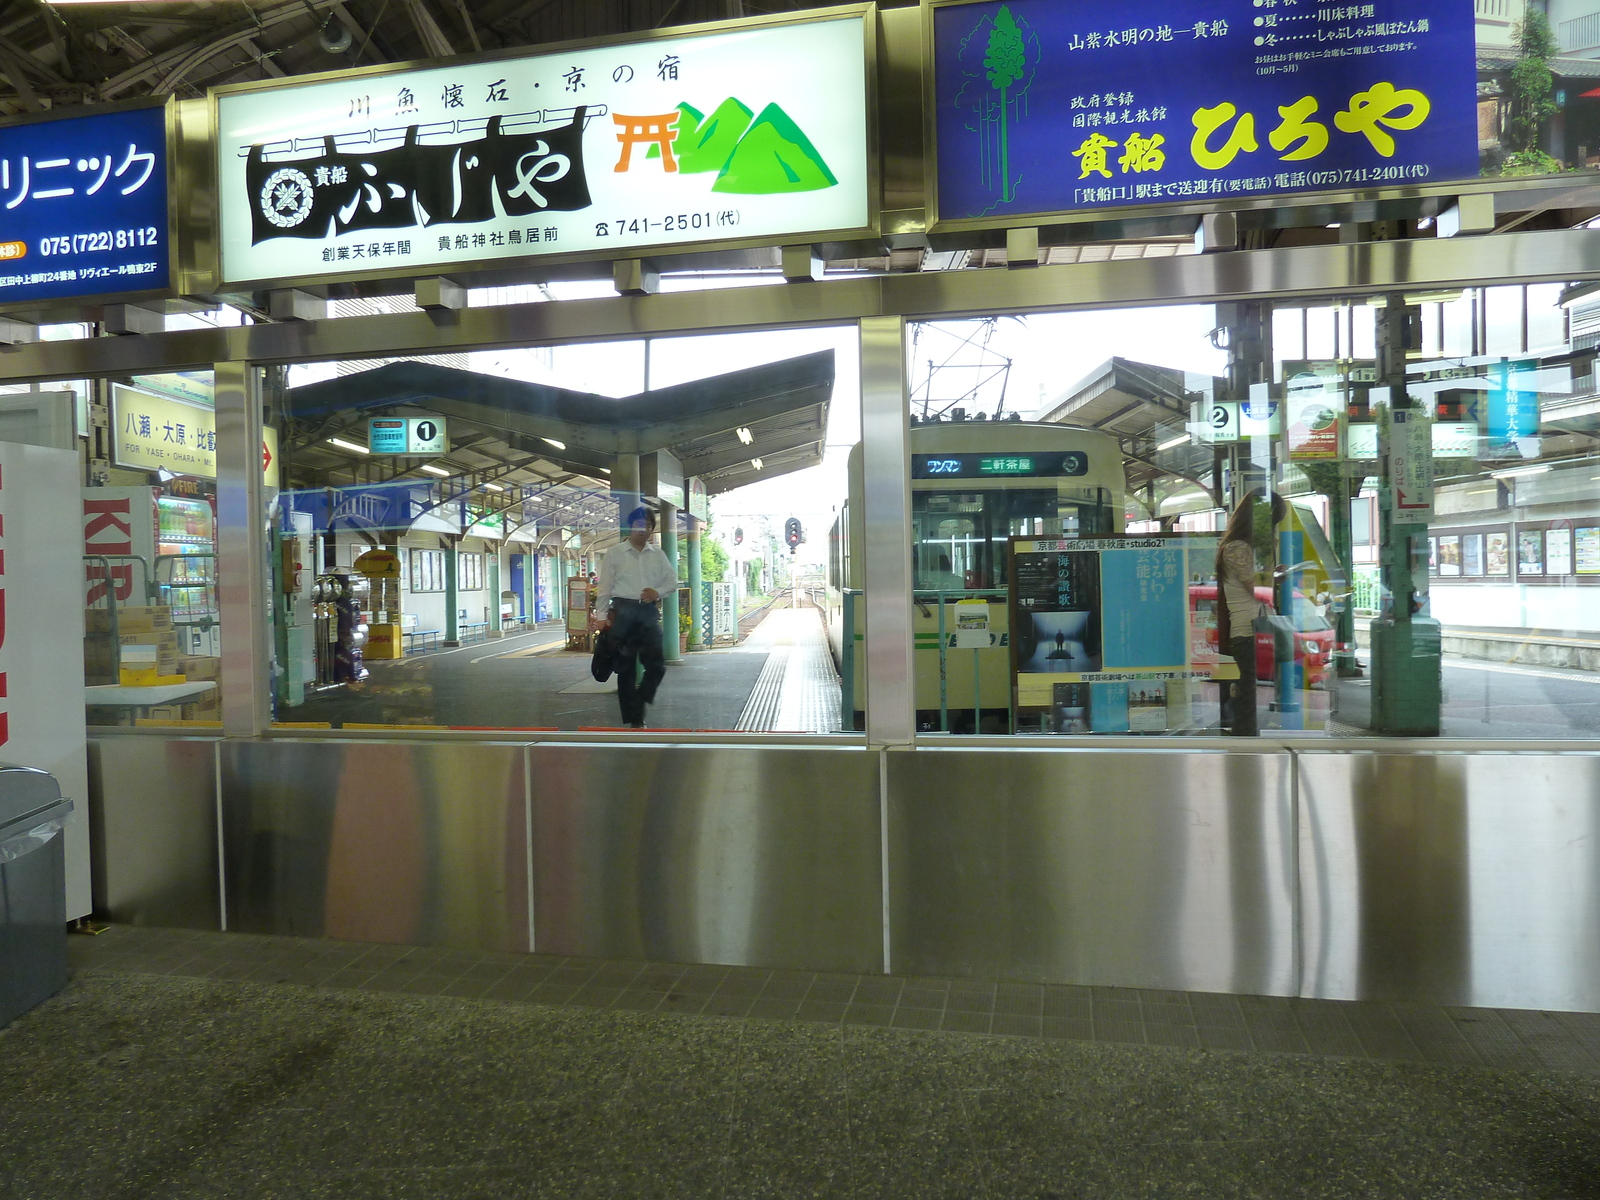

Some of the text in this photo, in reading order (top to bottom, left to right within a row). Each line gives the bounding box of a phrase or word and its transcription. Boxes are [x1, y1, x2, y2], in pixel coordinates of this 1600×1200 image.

[1070, 91, 1135, 110] 政府登録
[1190, 81, 1431, 171] ひろや
[1071, 132, 1167, 181] 貴船
[313, 165, 350, 188] 貴船
[39, 226, 158, 257] 075(722)8112
[320, 225, 559, 262] 創業天保年間 貴船神社鳥居前
[1211, 407, 1226, 426] 2
[420, 422, 430, 439] 1
[125, 443, 140, 454] FOR
[145, 447, 164, 458] YASE
[173, 452, 195, 463] OHARA
[927, 458, 1031, 473] ワンマン 二軒茶屋
[177, 478, 200, 495] FIRE
